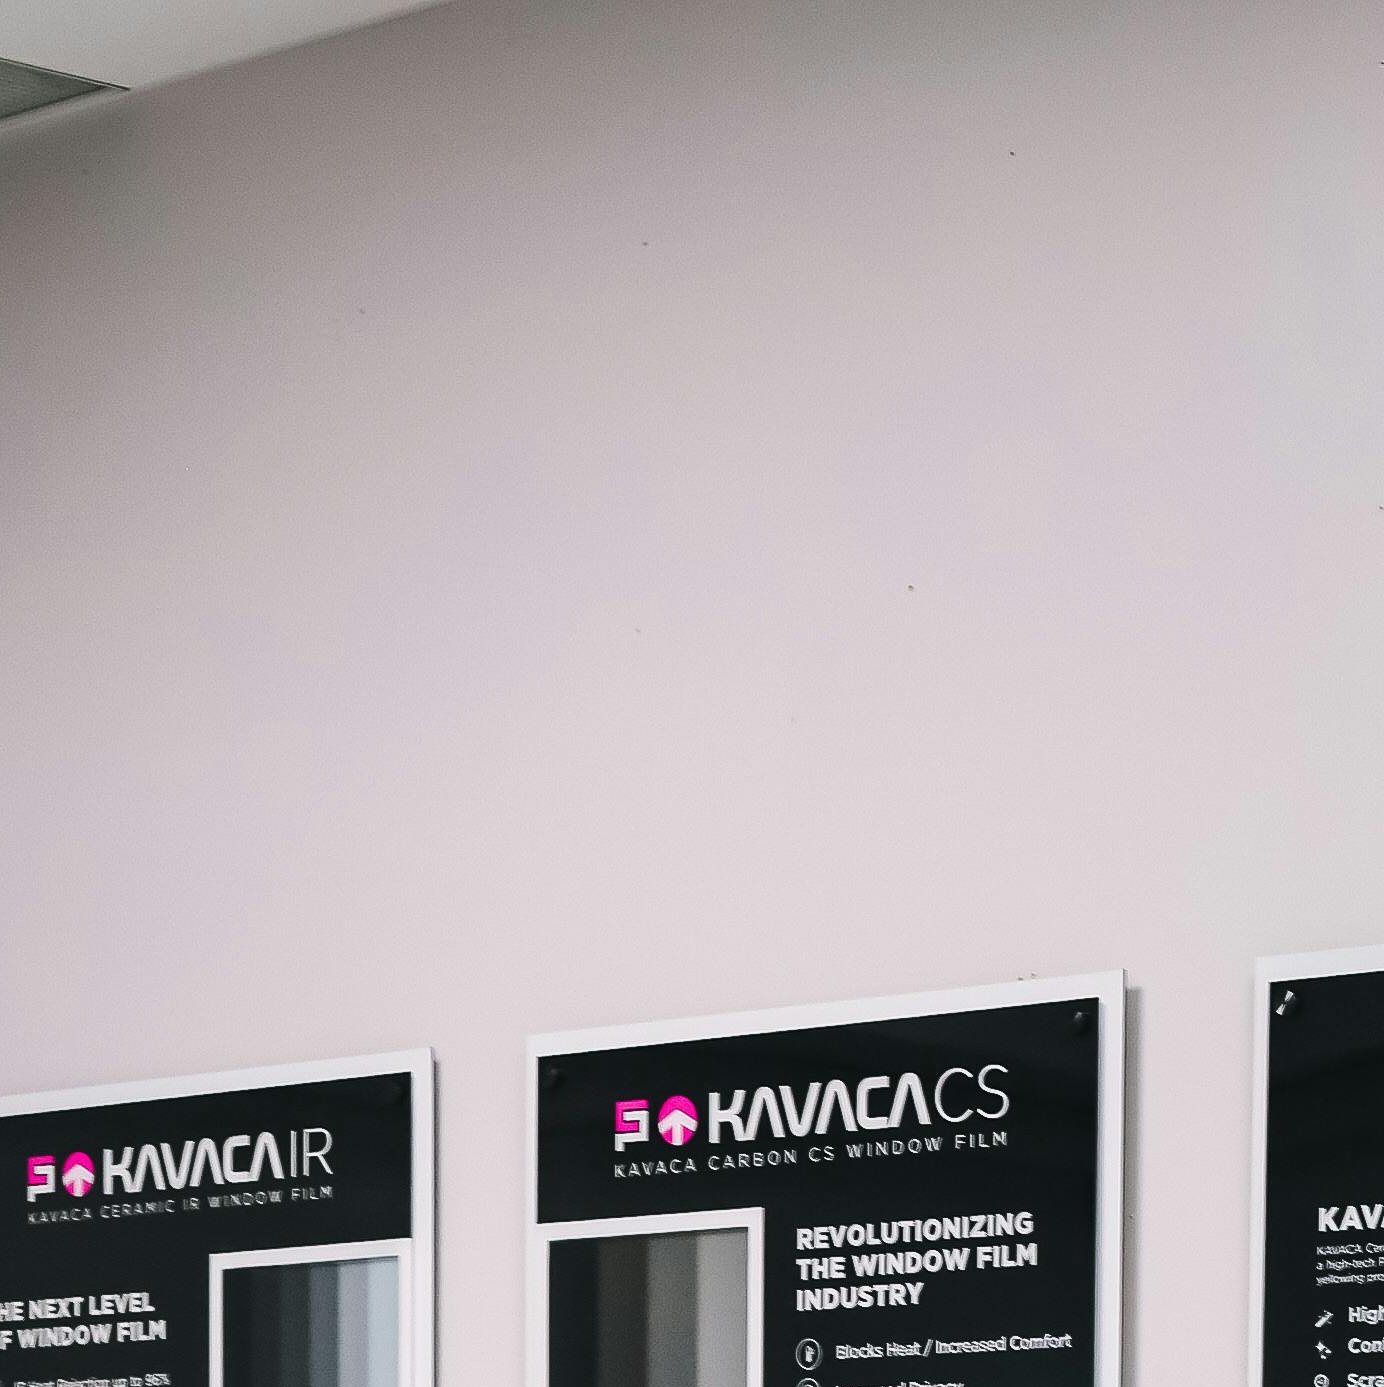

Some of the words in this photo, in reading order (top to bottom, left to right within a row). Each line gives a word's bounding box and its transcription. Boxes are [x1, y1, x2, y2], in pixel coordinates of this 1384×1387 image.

[615, 1158, 696, 1177] KAVACA
[708, 1150, 796, 1170] CARBON
[808, 1145, 835, 1163] CS
[846, 1137, 940, 1158] WINDOW
[954, 1131, 1008, 1150] FILM
[796, 1211, 1034, 1250] REVOLUTIONIZING
[1319, 1204, 1384, 1232] KAV
[796, 1257, 846, 1280] THE
[851, 1244, 970, 1276] WINDOW
[977, 1243, 1037, 1269] FILM
[29, 1297, 84, 1319] NEXT
[89, 1292, 155, 1315] LEVEL
[796, 1281, 924, 1311] INDUSTRY
[17, 1324, 112, 1348] WINDOW
[117, 1320, 166, 1342] FILM
[835, 1342, 885, 1360] Blocks
[885, 1341, 924, 1357] Heat
[923, 1339, 933, 1357] /
[935, 1335, 1007, 1354] Increased
[1009, 1333, 1073, 1351] Comfort
